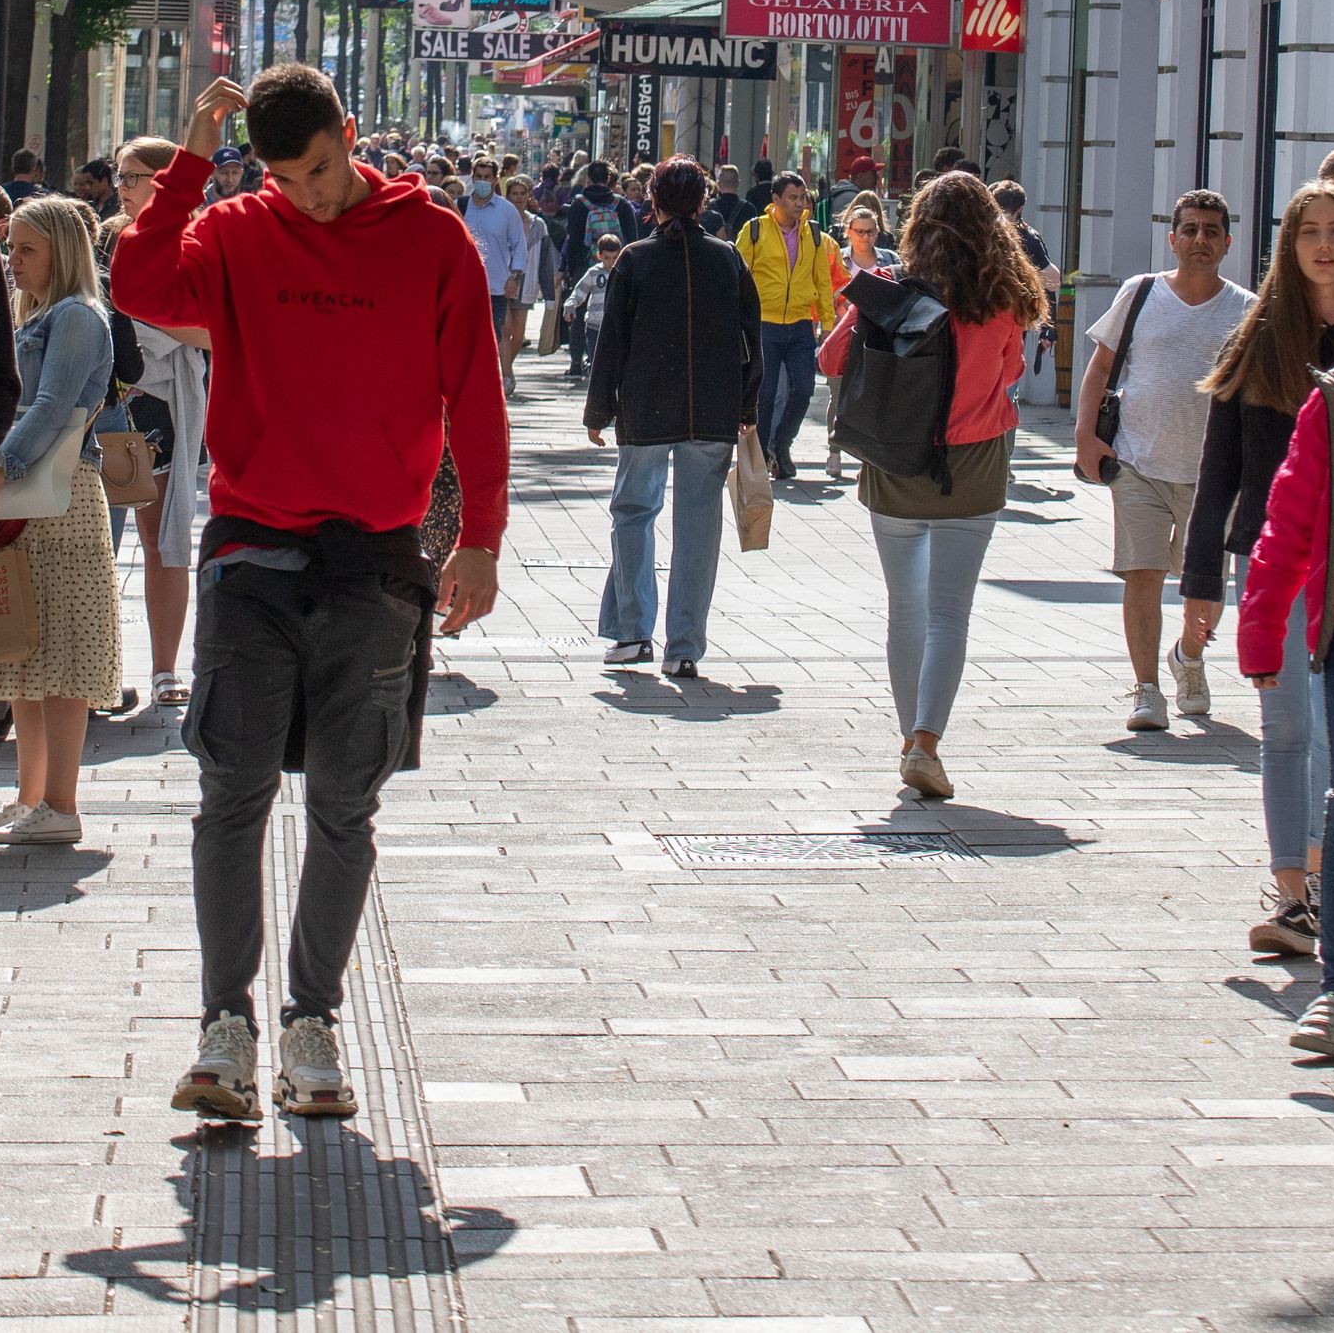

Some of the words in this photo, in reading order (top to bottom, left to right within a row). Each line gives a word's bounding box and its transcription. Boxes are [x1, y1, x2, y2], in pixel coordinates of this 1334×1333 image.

[767, 11, 909, 42] BORTOLOTTI
[420, 30, 468, 58] SALE
[482, 34, 530, 59] SALE
[611, 34, 765, 68] HUMANIC
[845, 90, 860, 100] BIS
[845, 102, 858, 112] ZU
